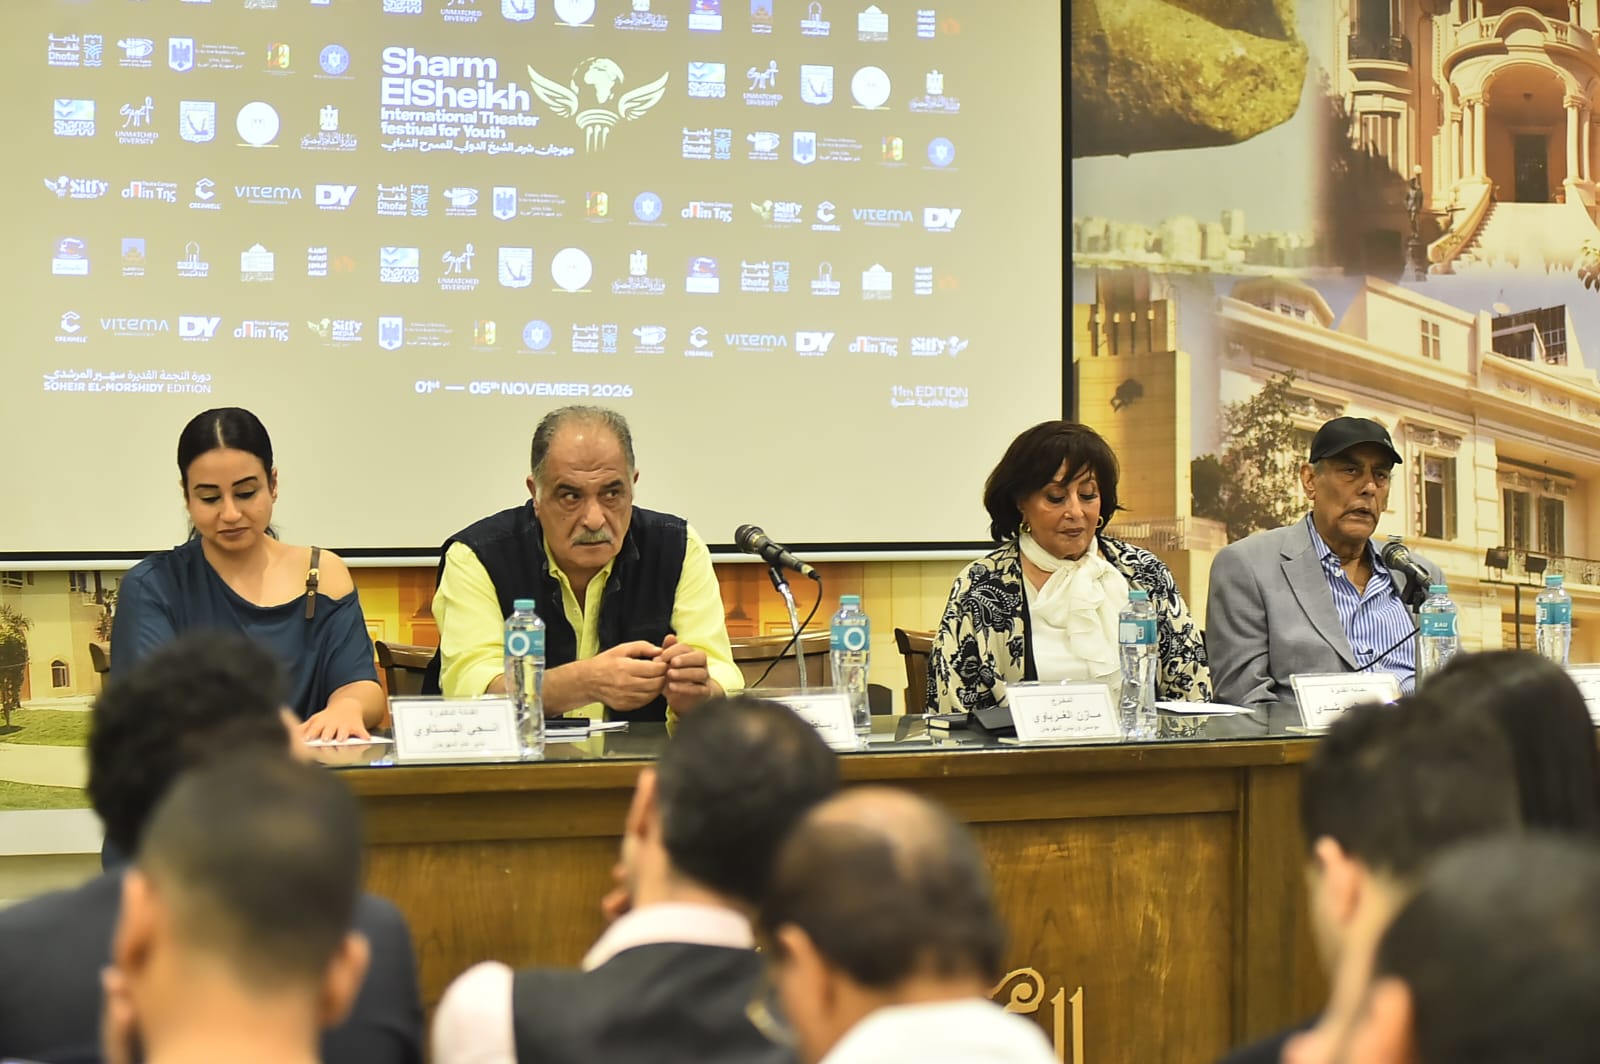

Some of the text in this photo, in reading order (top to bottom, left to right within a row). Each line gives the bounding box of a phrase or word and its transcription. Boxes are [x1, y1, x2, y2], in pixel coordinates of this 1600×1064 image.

[382, 46, 497, 80] Sharm
[381, 77, 531, 112] ElSheikh
[381, 107, 540, 127] International Theater
[381, 122, 506, 139] festival for Youth
[419, 140, 453, 152] للمسرح
[488, 142, 513, 155] الشيخ
[514, 144, 534, 155] شرم
[535, 144, 575, 157] مهرجان
[315, 184, 358, 206] DY
[923, 207, 962, 229] DY
[179, 316, 221, 338] DY
[795, 332, 835, 352] DY
[42, 368, 212, 384] دورة النجمة القديرة سهير المرشدي
[43, 381, 212, 393] SOHEIR EL-MORSHIDY EDITION
[415, 380, 440, 393] 01st
[469, 381, 500, 394] 05th
[501, 382, 589, 397] NOVEMBER
[592, 384, 633, 397] 2026
[915, 385, 969, 398] EDITION
